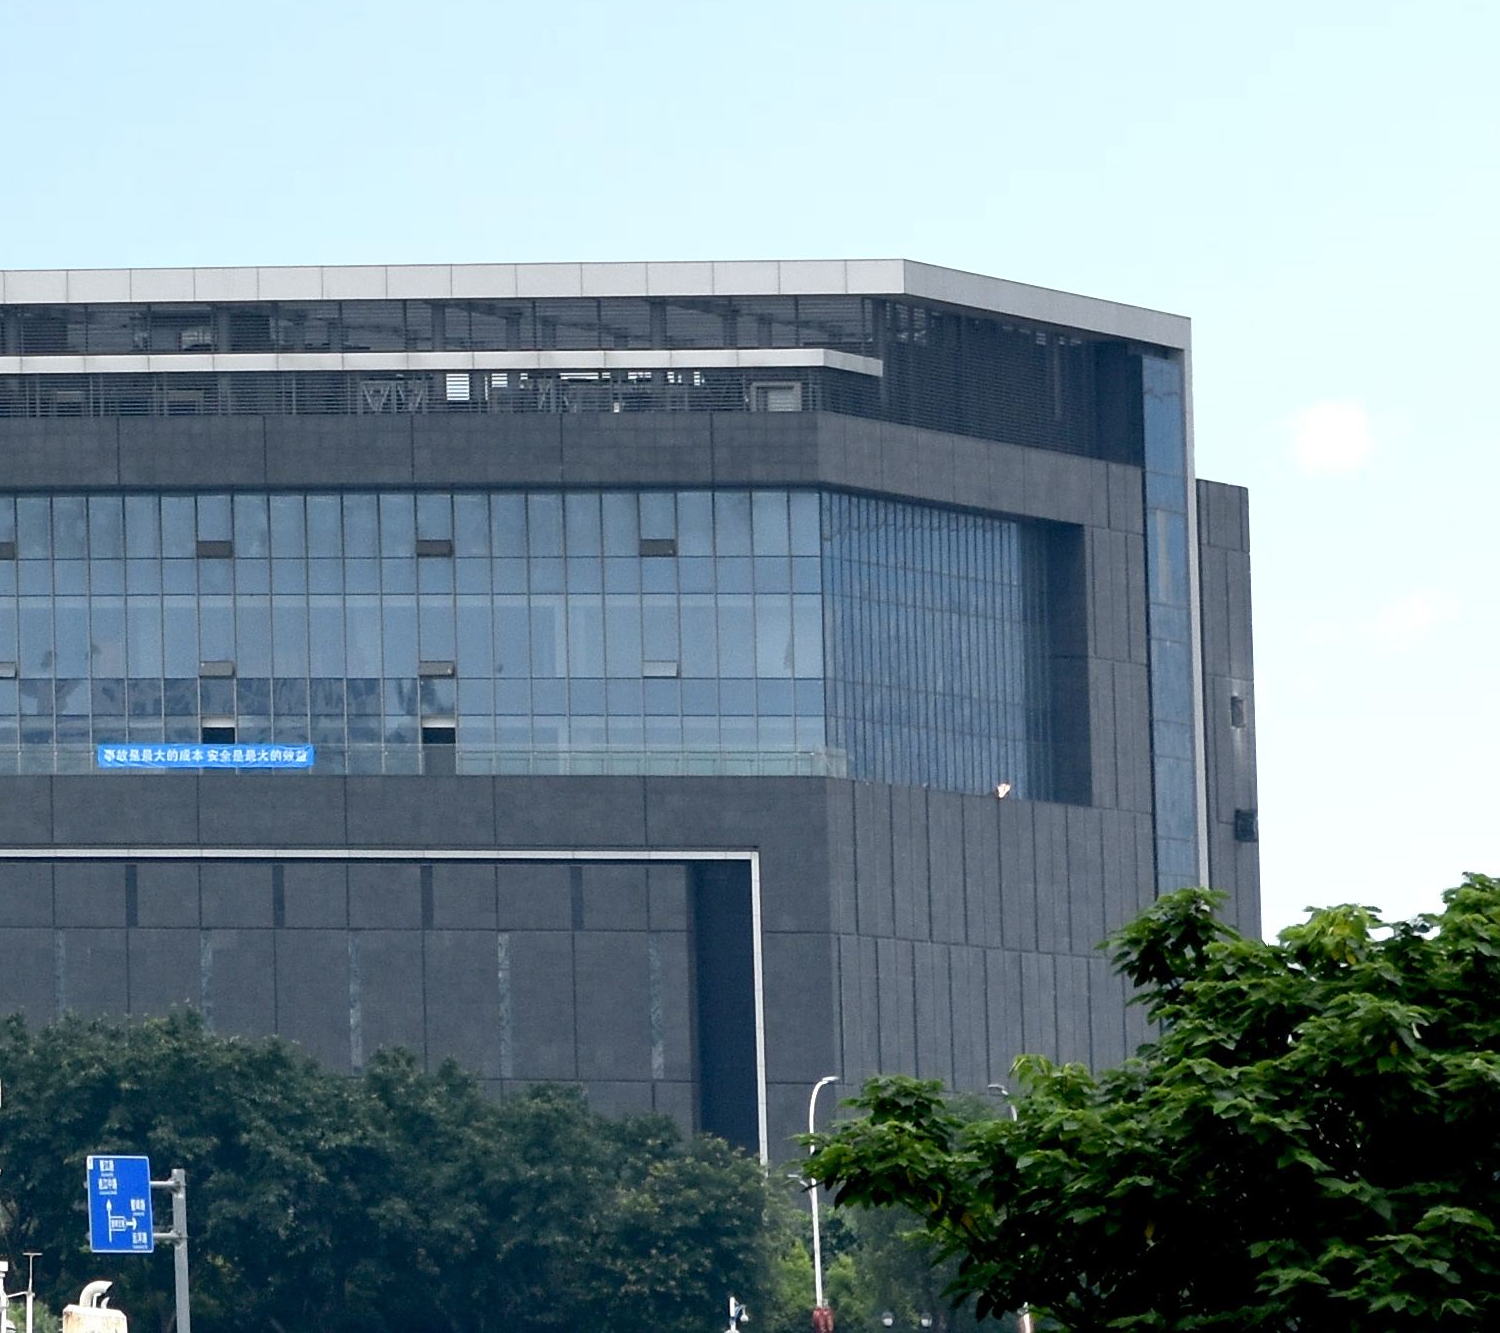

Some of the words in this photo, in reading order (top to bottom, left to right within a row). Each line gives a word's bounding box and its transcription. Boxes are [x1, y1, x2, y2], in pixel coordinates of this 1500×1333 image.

[104, 748, 203, 762] 事故是最大的成本
[207, 748, 308, 762] 安全是最大的效益
